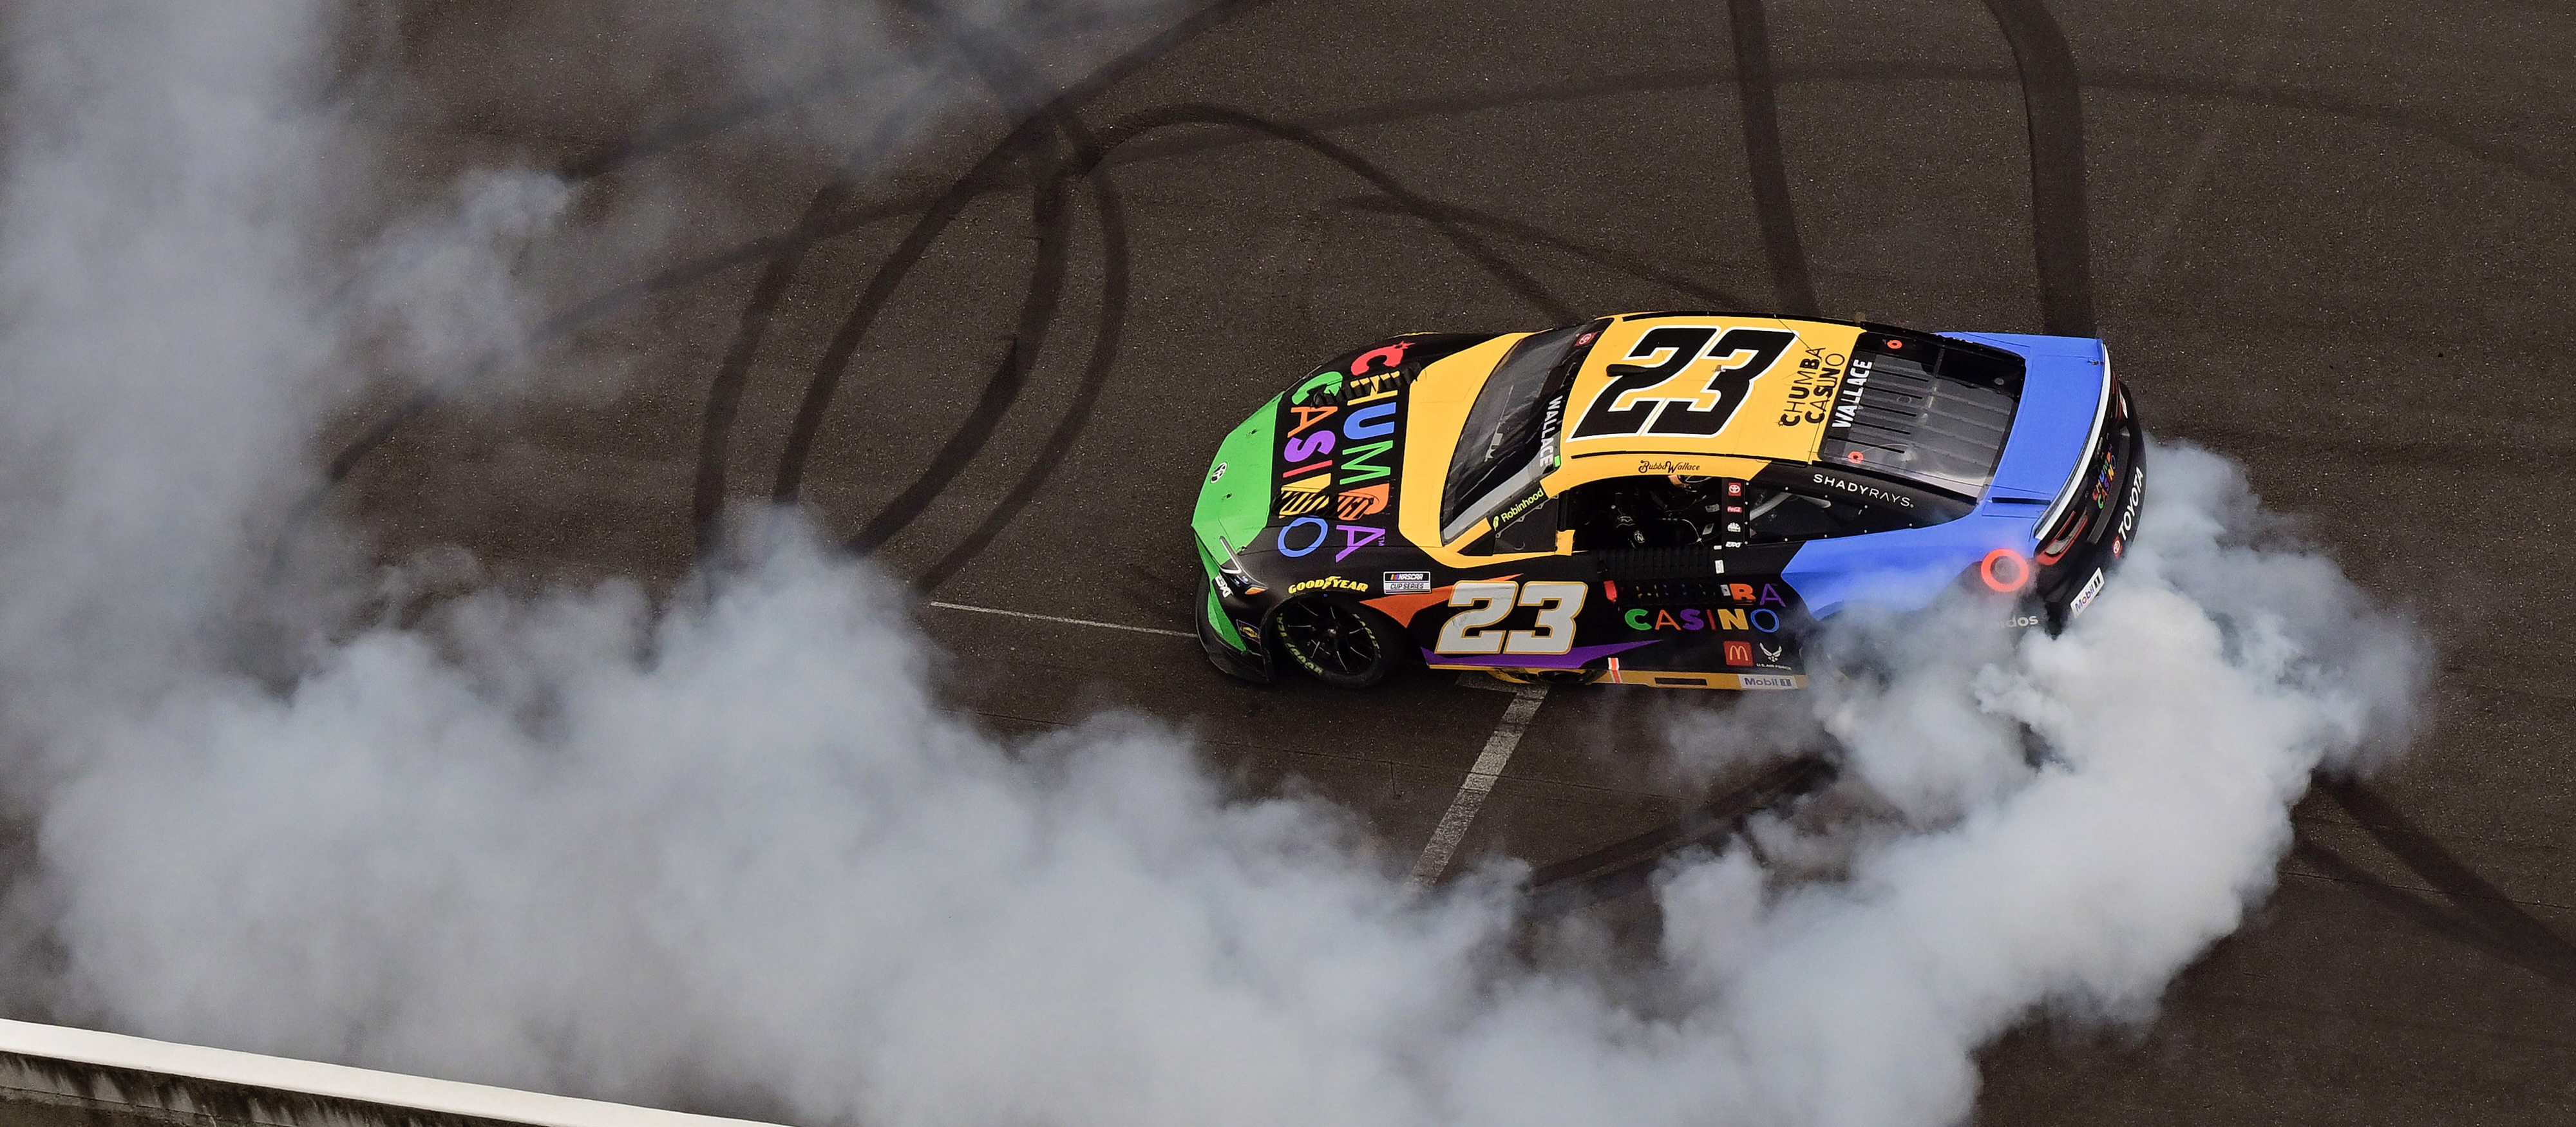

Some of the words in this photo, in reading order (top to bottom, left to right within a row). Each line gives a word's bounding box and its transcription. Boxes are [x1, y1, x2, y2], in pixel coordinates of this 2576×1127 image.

[1566, 325, 1800, 442] 23
[1776, 348, 1826, 426] CHUMBA
[1804, 353, 1845, 424] CASINO
[1832, 359, 1873, 428] WALLACE
[1278, 372, 1343, 558] CASINO
[1336, 342, 1409, 563] CHUMBA
[1540, 395, 1563, 467] WALLACE
[1638, 460, 1666, 473] Bubba
[1665, 461, 1700, 473] Wallace
[1501, 488, 1544, 522] Robinhood
[2118, 466, 2143, 541] TOYOTA
[1434, 580, 1588, 654] 23
[1624, 609, 1779, 633] CASINO
[2003, 615, 2038, 628] dos
[2075, 584, 2095, 612] Mobil
[1744, 677, 1778, 687] Mobil
